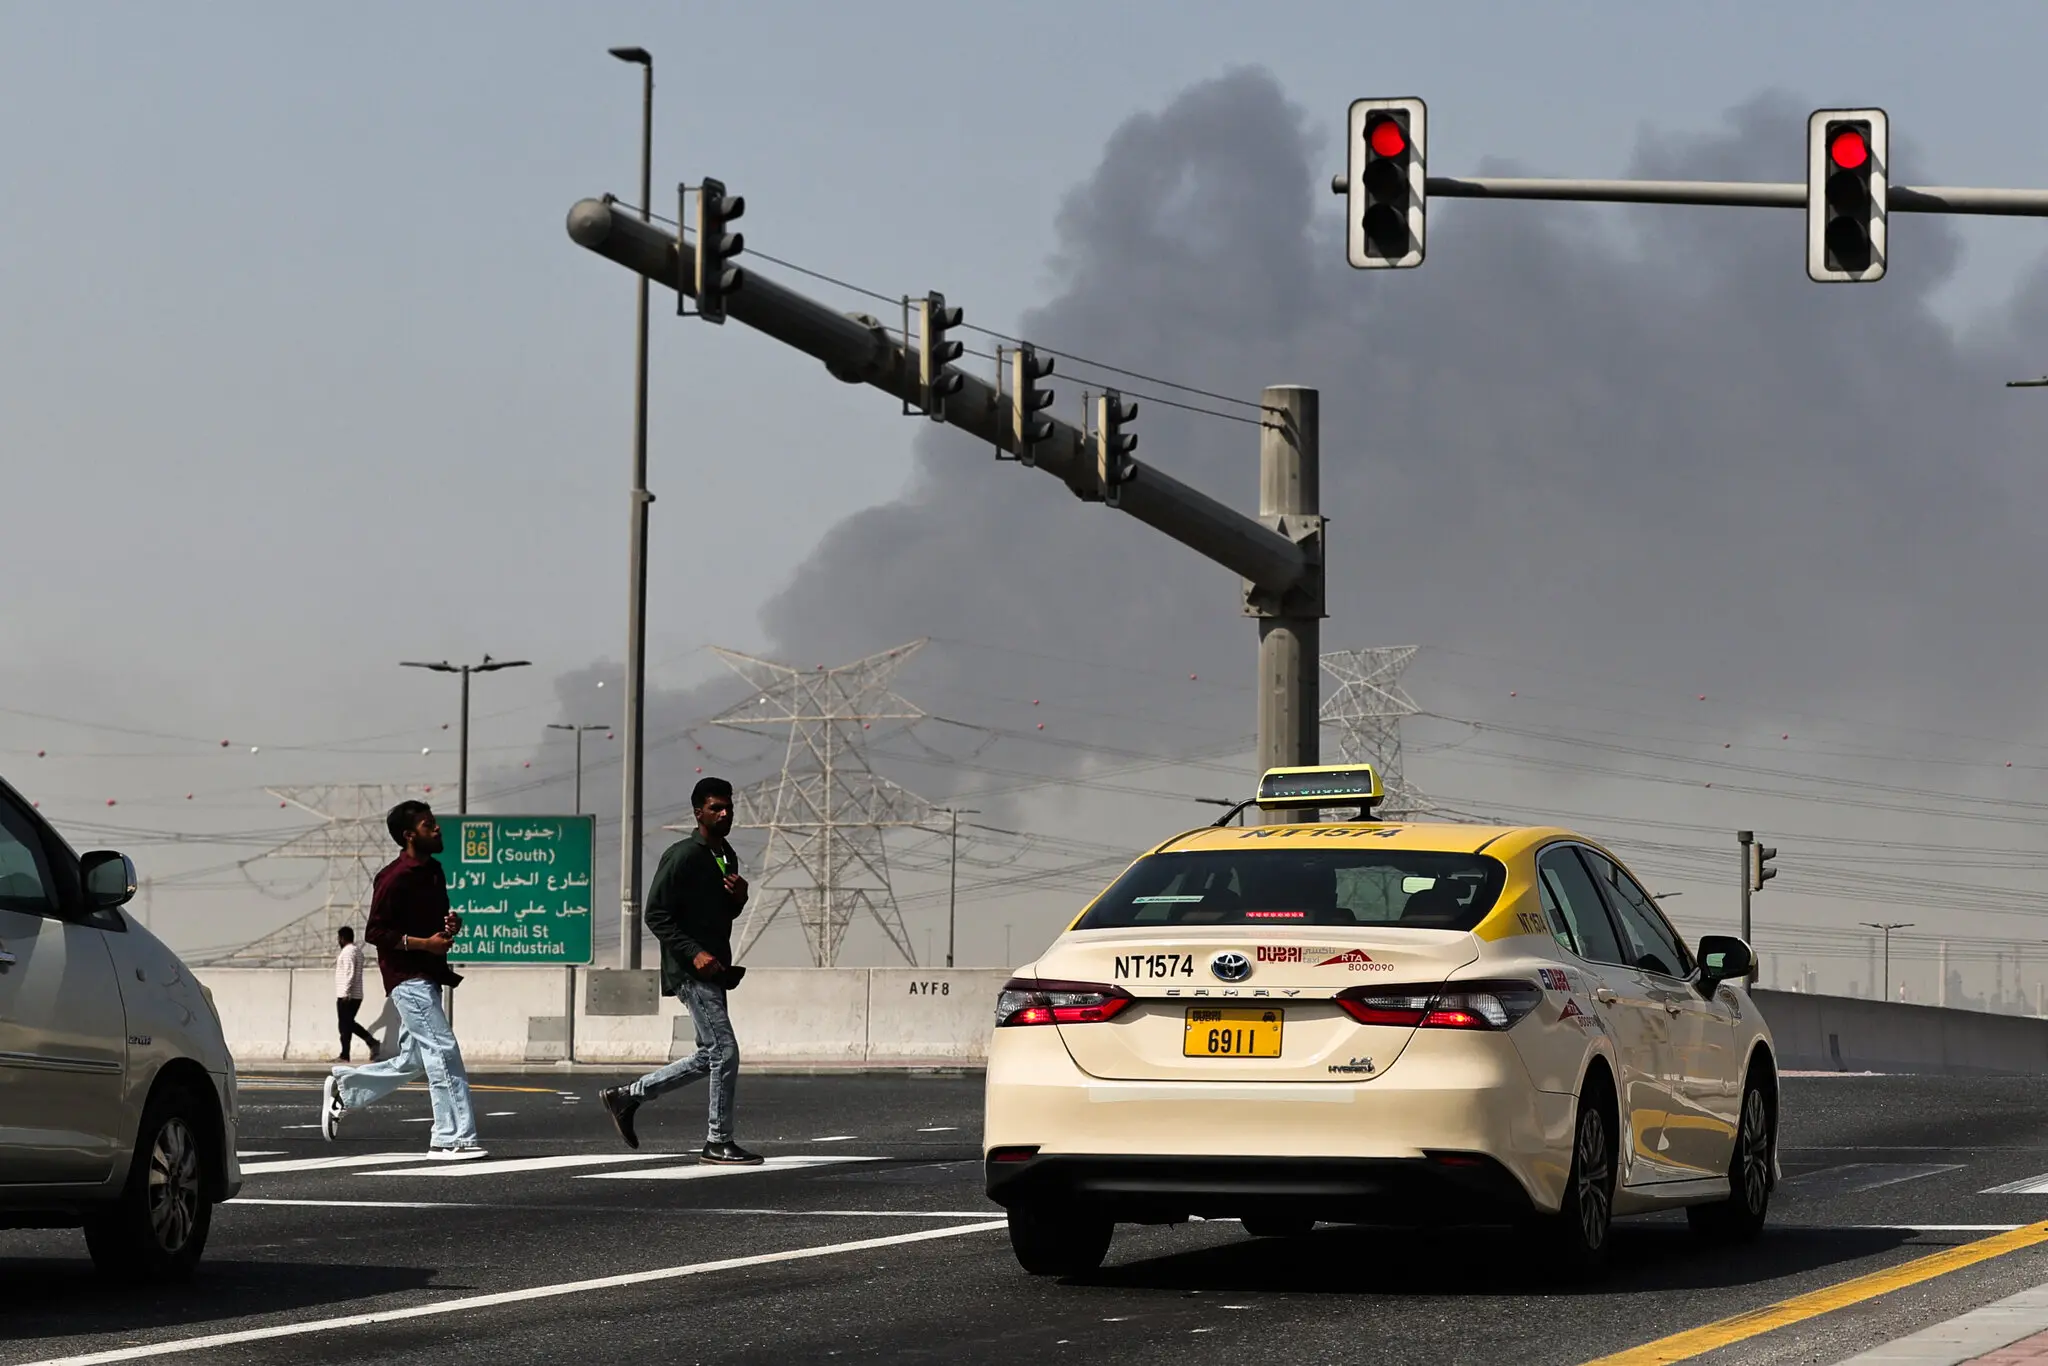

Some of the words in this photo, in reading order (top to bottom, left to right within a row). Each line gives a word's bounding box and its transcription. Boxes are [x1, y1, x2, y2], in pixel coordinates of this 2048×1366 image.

[467, 841, 488, 857] 86
[497, 848, 556, 865] (South)
[493, 872, 539, 890] الخيل
[547, 872, 589, 891] شارع
[514, 900, 547, 922] علي
[555, 900, 588, 917] جبل
[473, 925, 488, 938] Al
[493, 925, 528, 938] Khail
[532, 925, 549, 938] St
[447, 941, 474, 954] bal
[477, 941, 495, 954] Ali
[500, 941, 565, 954] Industrial
[1257, 946, 1302, 963] DUBAI
[1115, 954, 1194, 978] NT1574
[1303, 955, 1320, 963] taxi
[1341, 954, 1363, 962] RTA
[1348, 963, 1394, 972] 8009090
[909, 981, 950, 996] AYF8
[1166, 988, 1300, 998] CAMRY
[1208, 1029, 1255, 1054] 6911
